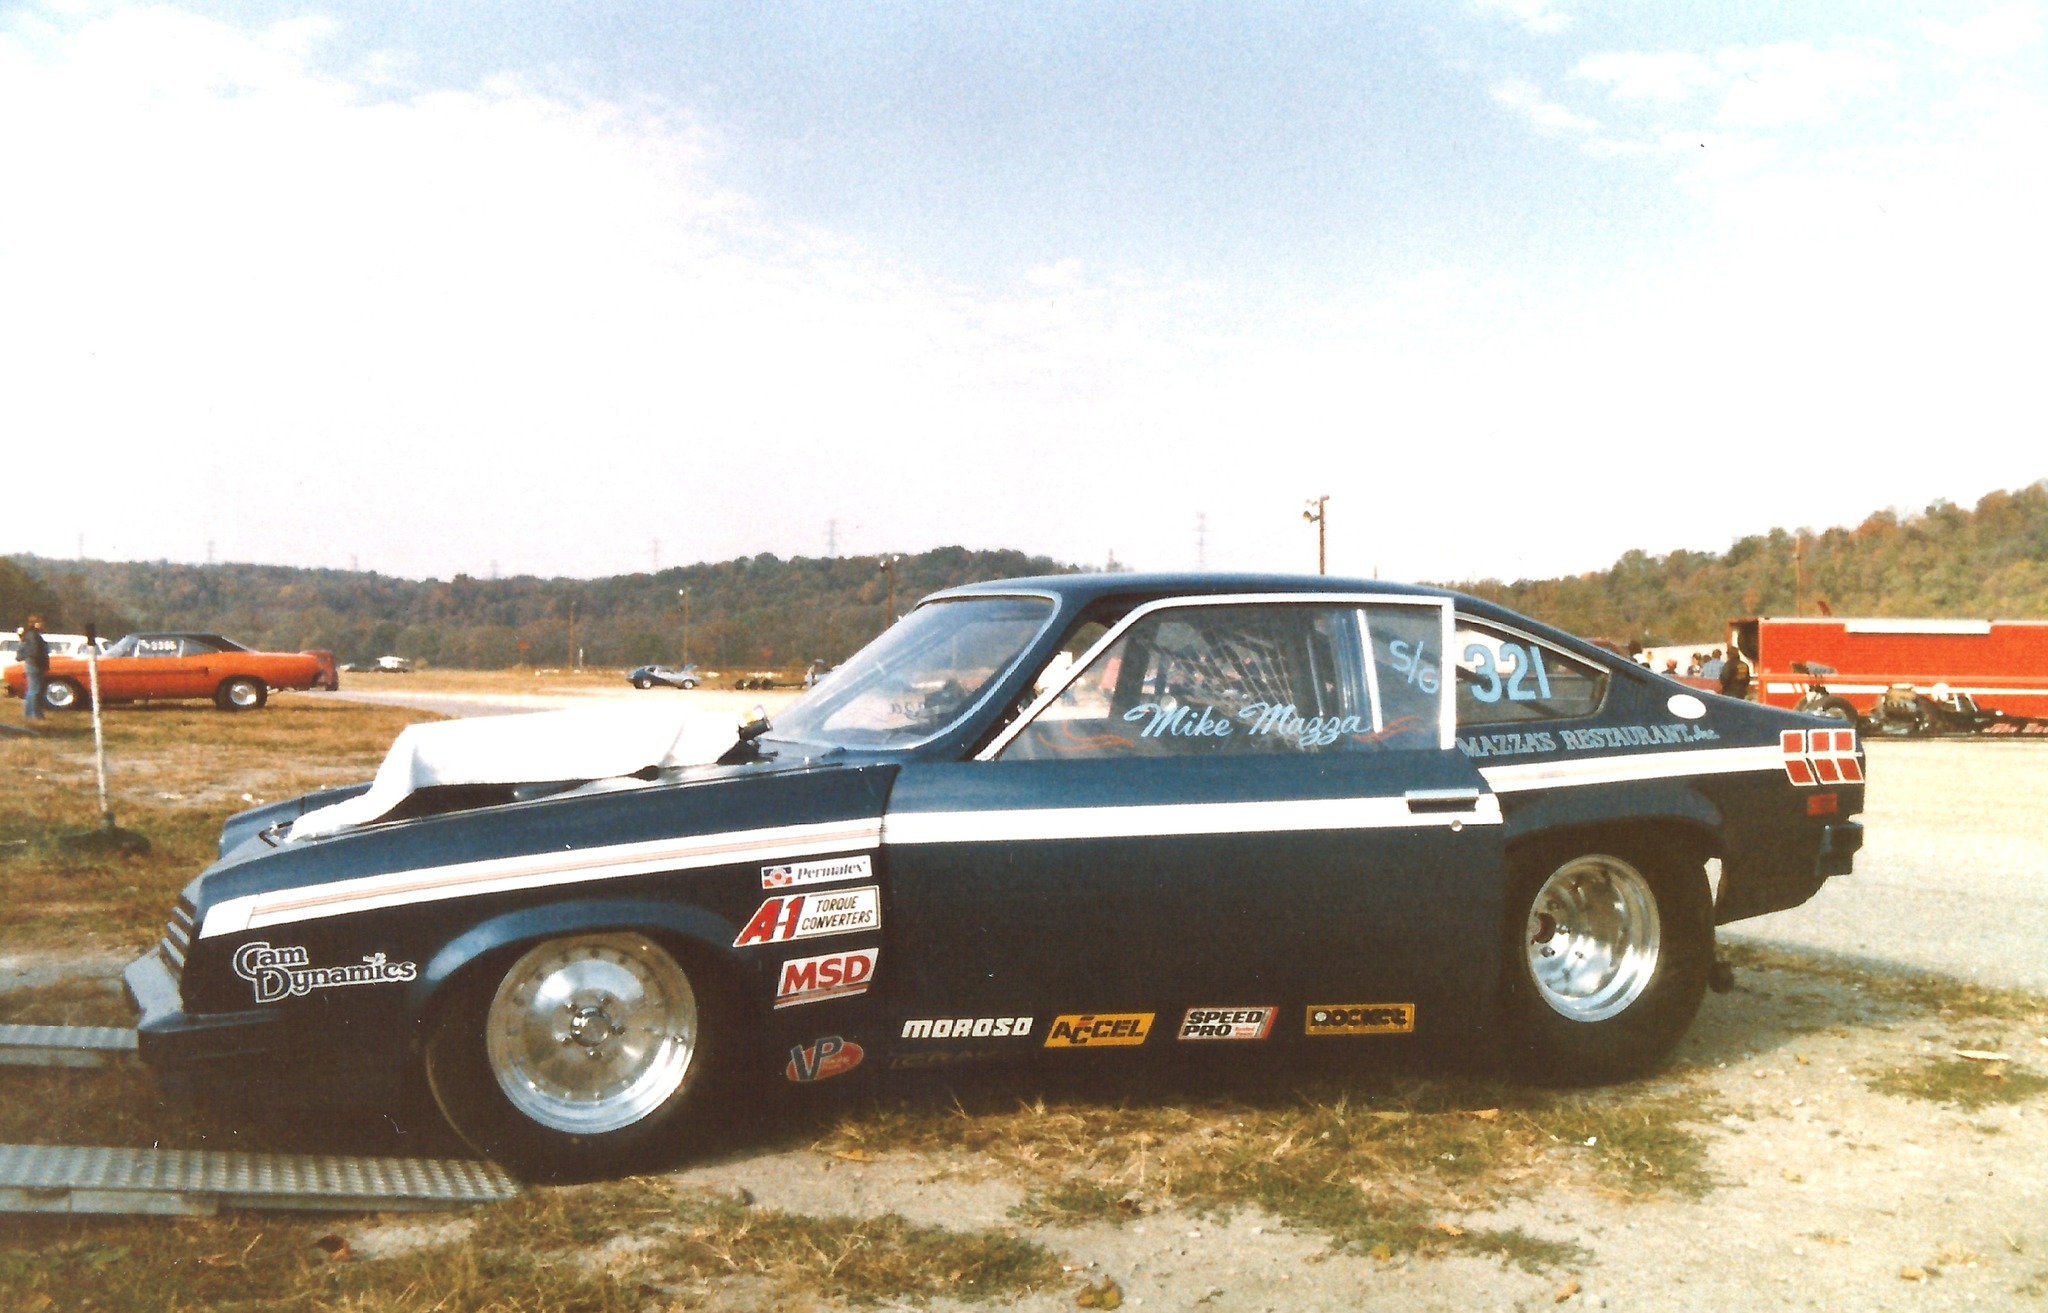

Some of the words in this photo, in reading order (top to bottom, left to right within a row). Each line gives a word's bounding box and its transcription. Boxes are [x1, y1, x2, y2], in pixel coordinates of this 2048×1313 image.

[1464, 643, 1551, 703] 321
[1123, 702, 1234, 738] Mike
[1238, 702, 1372, 747] Mazza
[801, 909, 874, 931] CONVERTERS
[815, 895, 859, 913] TORQUE
[232, 941, 309, 982] Cam
[252, 954, 418, 1003] Dynamics
[781, 955, 872, 995] MSD
[901, 1016, 1034, 1039] MOROSO
[1051, 1014, 1146, 1044] ACCEL
[1182, 1024, 1233, 1037] PRO
[1187, 1010, 1264, 1025] SPEED
[790, 1035, 845, 1081] VP
